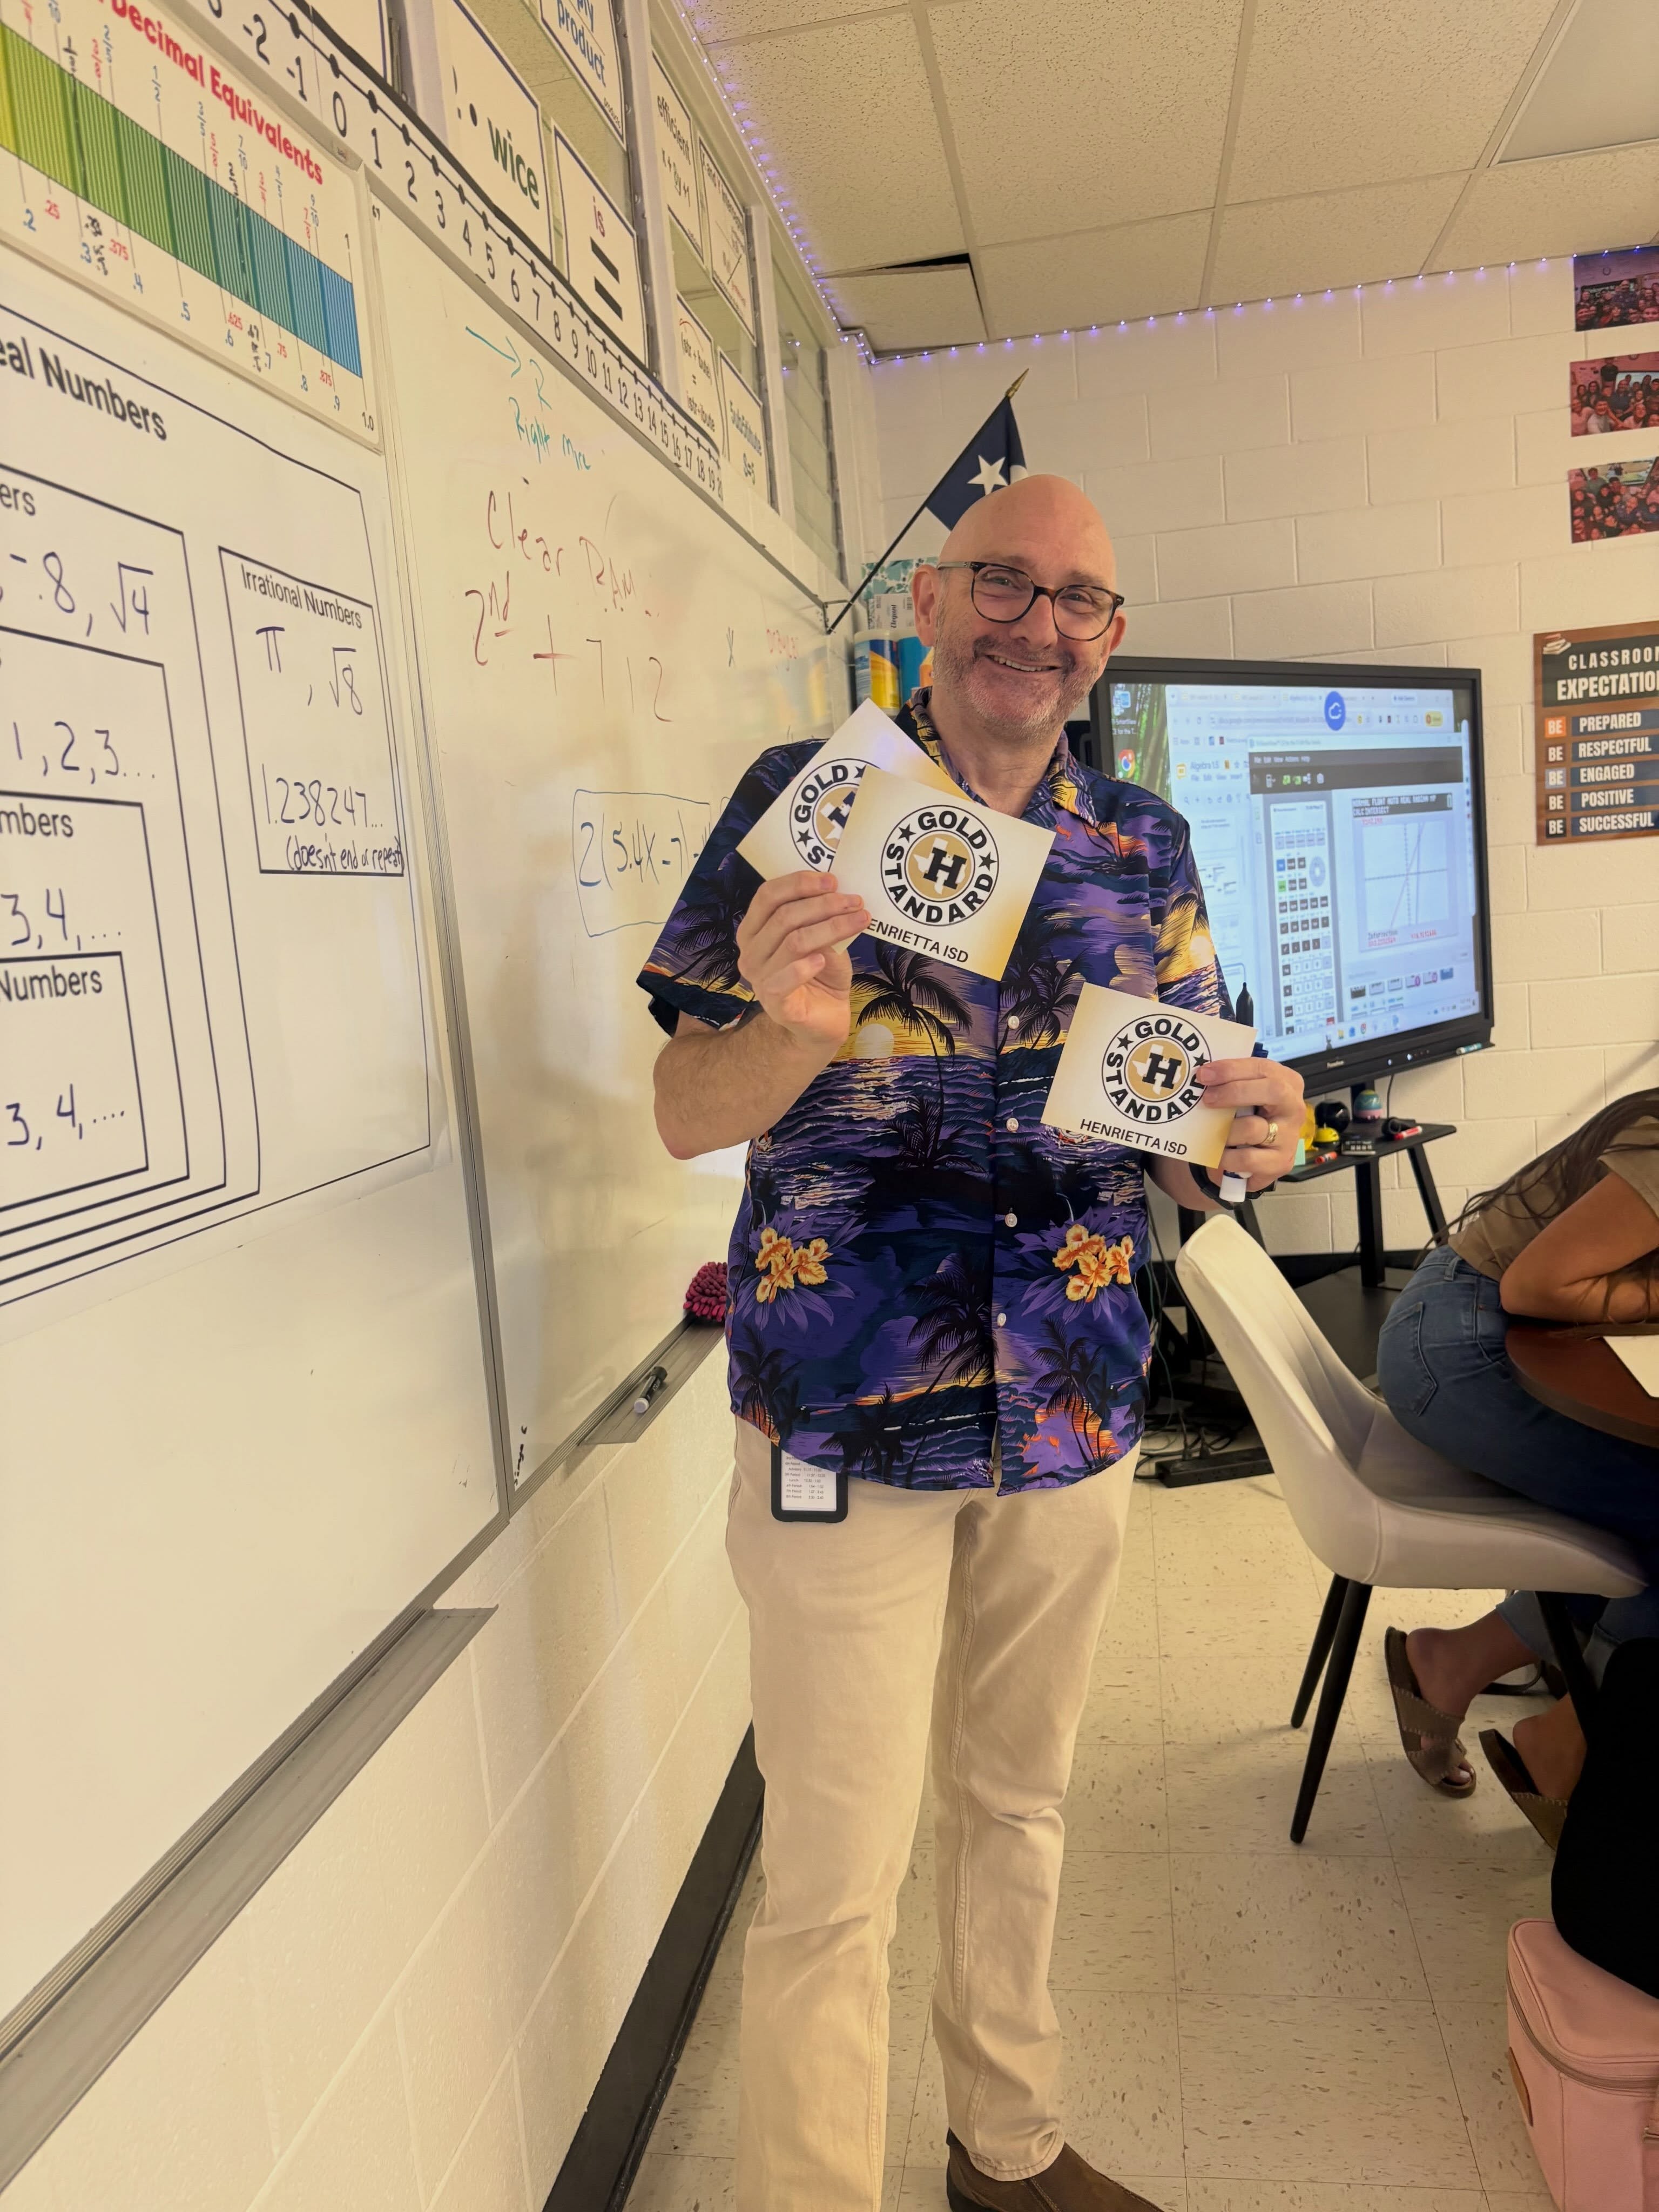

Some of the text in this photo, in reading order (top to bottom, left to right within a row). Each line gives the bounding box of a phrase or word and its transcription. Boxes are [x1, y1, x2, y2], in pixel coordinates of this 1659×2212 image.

[210, 65, 323, 185] Equivalents
[592, 194, 605, 238] is
[242, 14, 270, 65] -2
[286, 56, 307, 102] -1
[333, 91, 347, 138] 0
[371, 127, 382, 169] 1
[405, 160, 418, 203] 2
[435, 190, 446, 230] 3
[462, 219, 472, 257] 4
[485, 241, 495, 280] 5
[510, 268, 520, 302] 6
[532, 287, 541, 322] 7
[553, 309, 561, 342] 8
[571, 328, 579, 359] 9
[585, 345, 597, 379] 10
[602, 362, 613, 395] 11
[618, 377, 629, 409] 12
[633, 392, 644, 423] 13
[648, 406, 657, 436] 14
[660, 420, 669, 448] 15
[672, 433, 682, 463] 16
[684, 445, 692, 471] 17
[696, 456, 705, 482] 18
[707, 466, 716, 491] 19
[38, 347, 167, 441] Numbers
[487, 490, 564, 577] Clear
[240, 562, 362, 630] Irrational Numbers
[1557, 670, 1659, 702] EXPECTATIO
[1548, 711, 1642, 736] BE PREPARED
[1548, 736, 1652, 763] BE RESPECTFUL
[1548, 763, 1635, 786] BE ENGAGED
[794, 764, 849, 824] GOLD
[1548, 788, 1635, 811] BE POSITIVE
[918, 810, 988, 849] GOLD
[1548, 811, 1655, 835] BE SUCCESSFUL
[340, 840, 359, 870] end
[884, 843, 994, 923] STANDARD
[867, 918, 969, 963] ENRIETTA ISD
[0, 965, 103, 1002] Numbers
[1135, 1019, 1200, 1053] GOLD
[1080, 1118, 1188, 1156] HENRIETTA ISD
